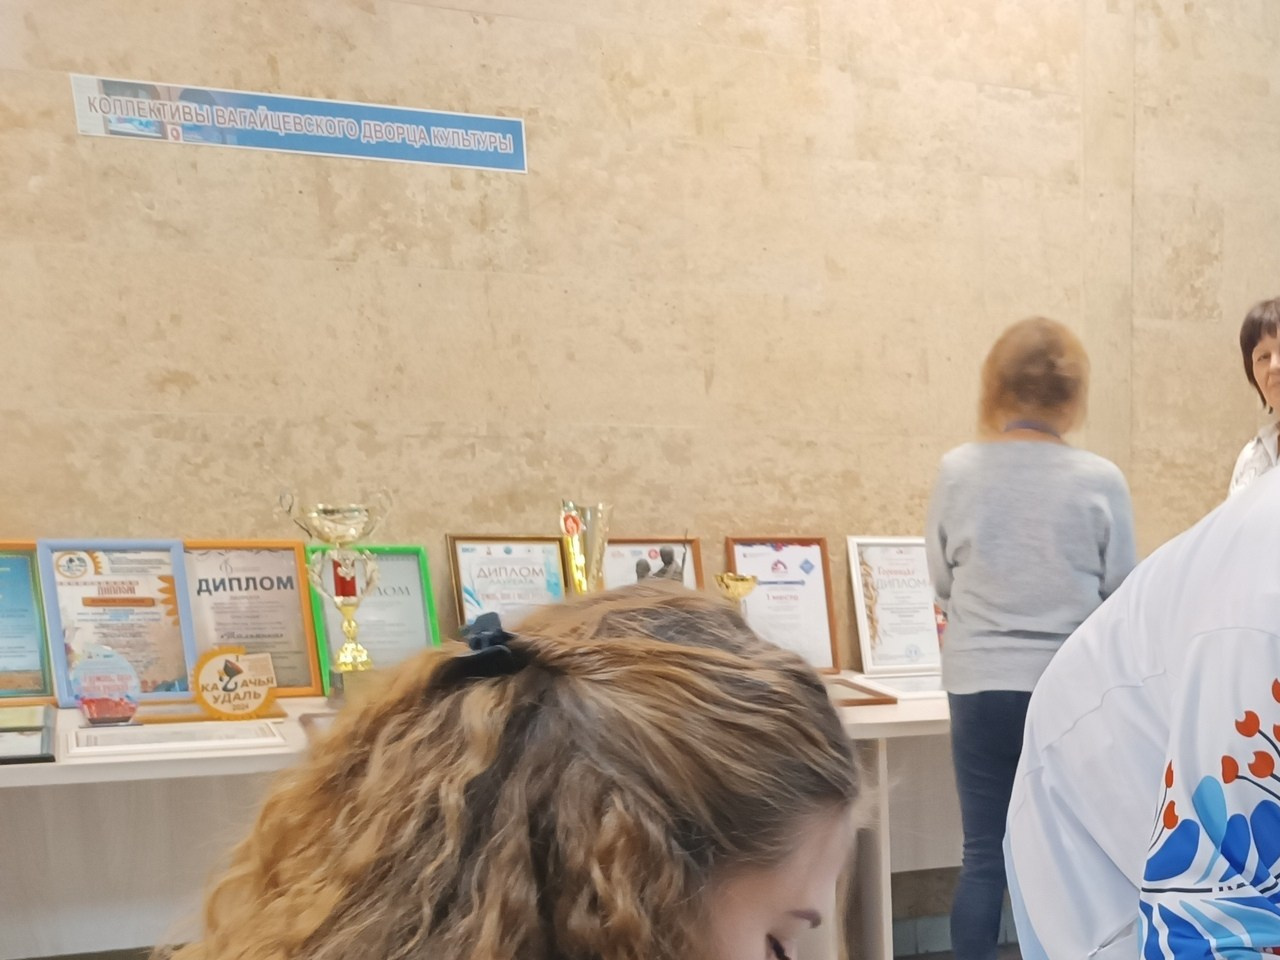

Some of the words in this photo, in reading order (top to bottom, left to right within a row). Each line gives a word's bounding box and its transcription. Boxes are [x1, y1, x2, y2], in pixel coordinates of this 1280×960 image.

[87, 96, 211, 124] КОЛЛЕКТИВЫ
[214, 106, 359, 138] ВАГАЙЦЕВСКОГО
[361, 121, 428, 147] ДВОРЦА
[431, 127, 514, 153] КУЛЬТУРЫ
[476, 566, 545, 579] ДИПЛОМ
[196, 575, 295, 596] ДИПЛОМ
[212, 691, 262, 705] УДАЛЬ
